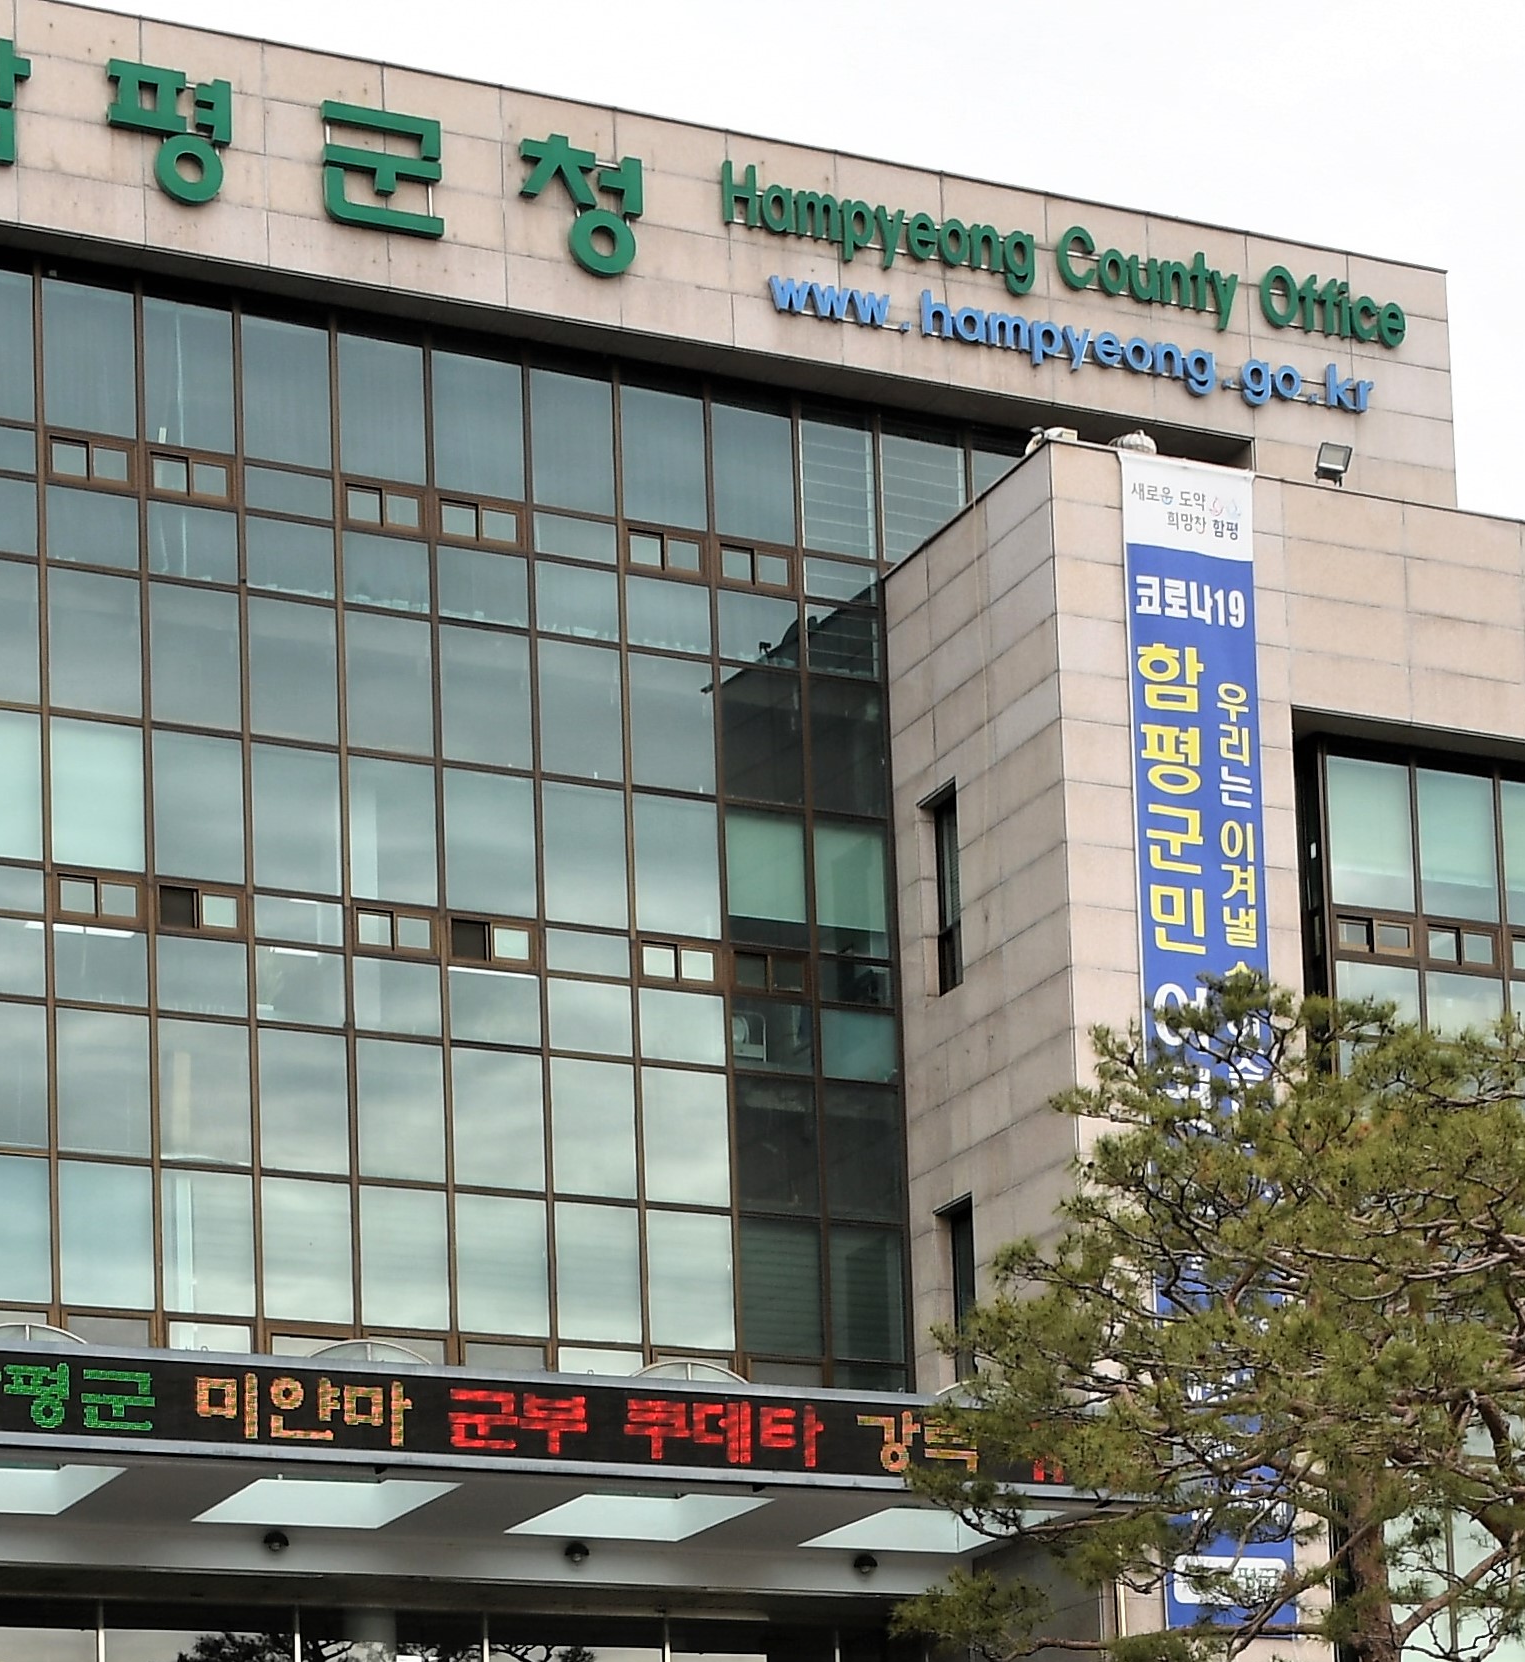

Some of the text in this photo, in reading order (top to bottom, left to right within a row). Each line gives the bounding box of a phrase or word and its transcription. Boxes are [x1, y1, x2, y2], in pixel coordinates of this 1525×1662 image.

[721, 159, 1406, 349] Hampyeong County Office
[768, 275, 1374, 414] www.hampyeong.go.kr
[1131, 483, 1206, 511] 새로운 도약
[1167, 512, 1239, 540] 희망찬 함평
[1135, 575, 1245, 628] 코로나19
[1137, 642, 1207, 956] 함평군민
[1217, 683, 1253, 809] 우리는
[1219, 820, 1258, 949] 이겨낼
[195, 1372, 413, 1447] 미얀마
[447, 1388, 588, 1455] 군부
[624, 1399, 824, 1468] 쿠데타
